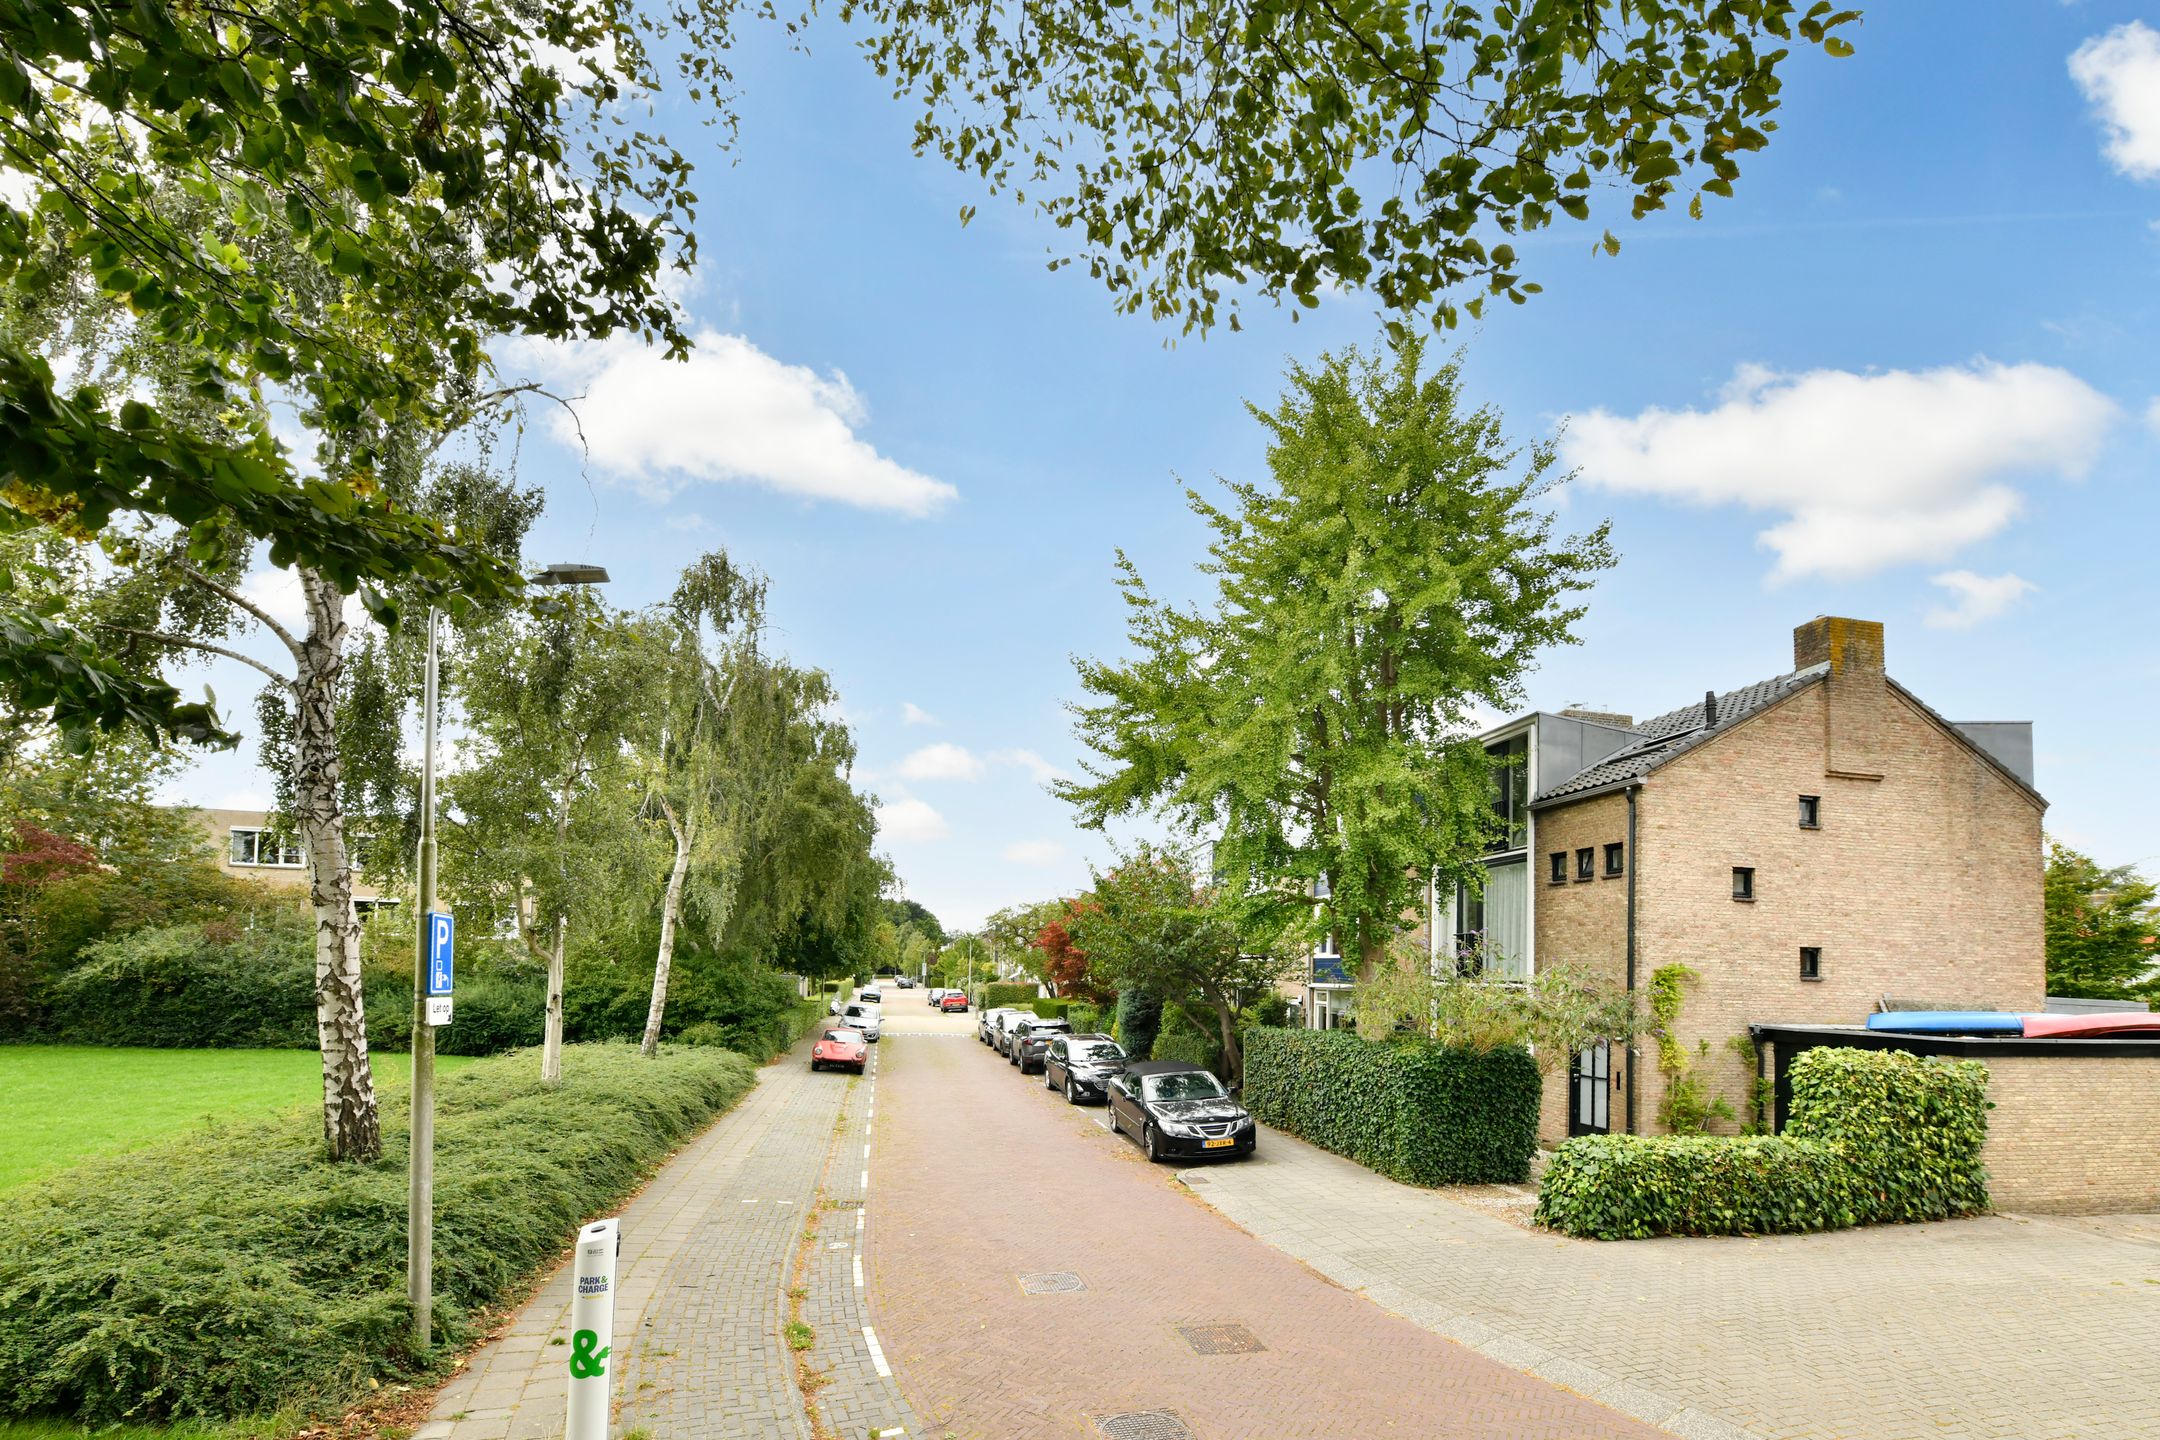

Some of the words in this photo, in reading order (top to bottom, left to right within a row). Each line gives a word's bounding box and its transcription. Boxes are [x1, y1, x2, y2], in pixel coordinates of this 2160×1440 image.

[436, 919, 449, 959] P
[432, 1003, 442, 1013] Let
[442, 1004, 450, 1015] op
[578, 1283, 609, 1293] CHARGE
